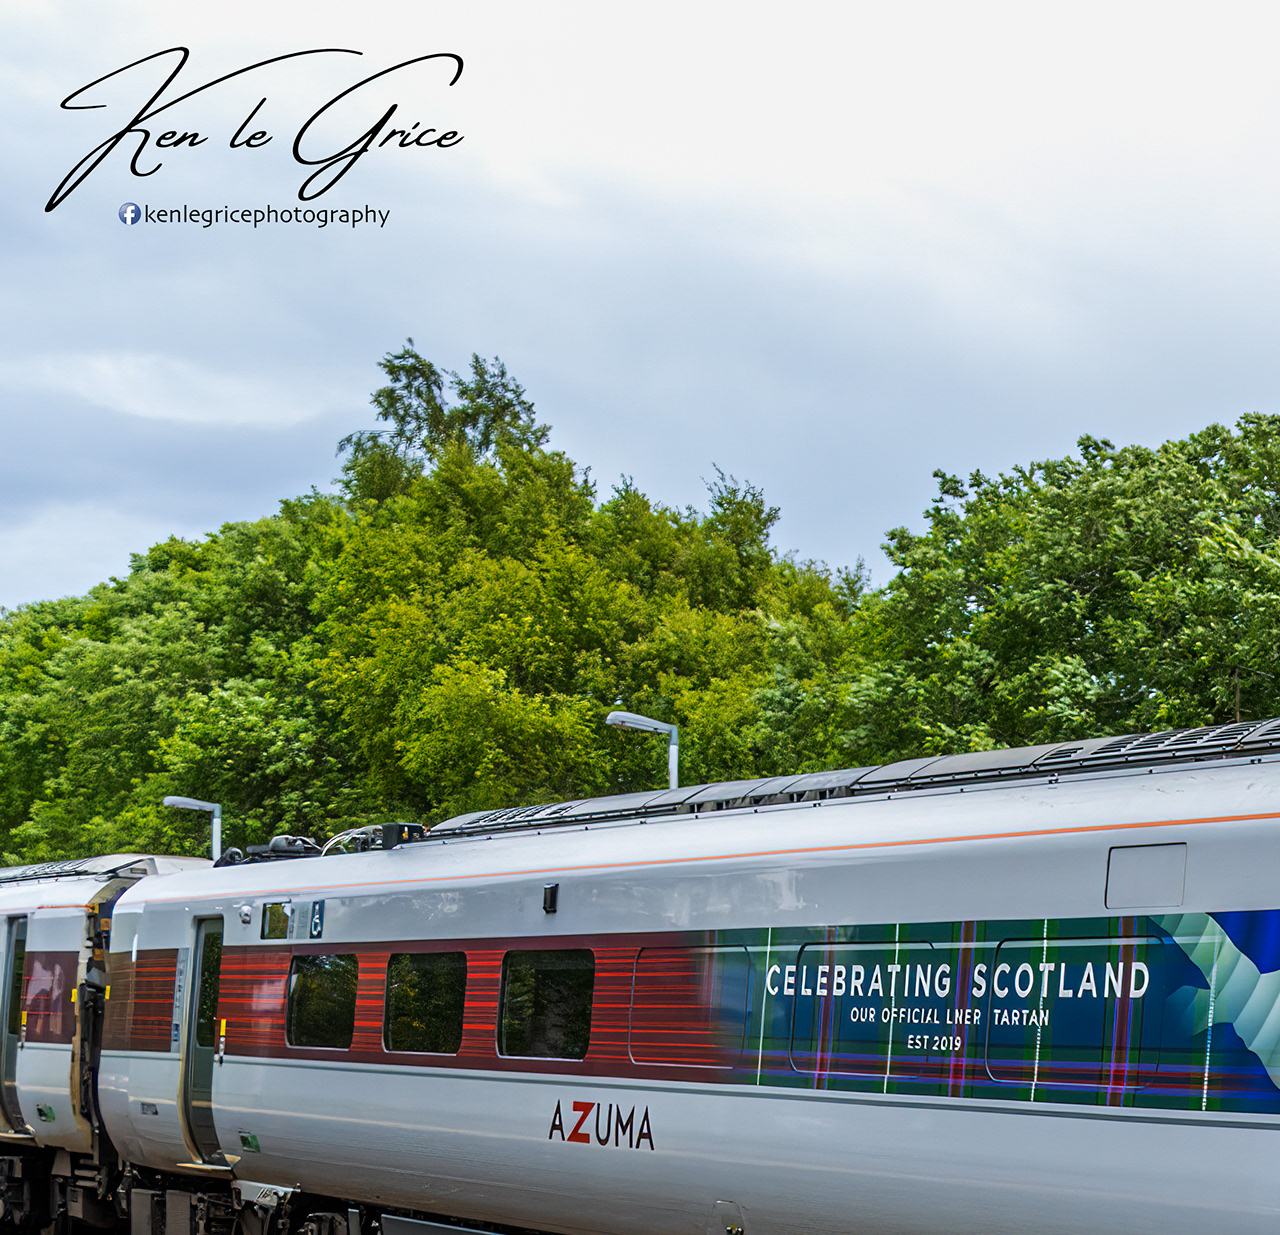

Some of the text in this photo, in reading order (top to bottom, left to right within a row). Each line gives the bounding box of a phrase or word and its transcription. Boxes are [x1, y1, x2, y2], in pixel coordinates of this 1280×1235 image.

[766, 961, 1151, 999] CELEBRATING SCOTLAND
[850, 1006, 1050, 1027] OUR OFFICIAL LNER TARTAN
[907, 1034, 962, 1052] EST 2019
[548, 1098, 655, 1151] AZUMA
